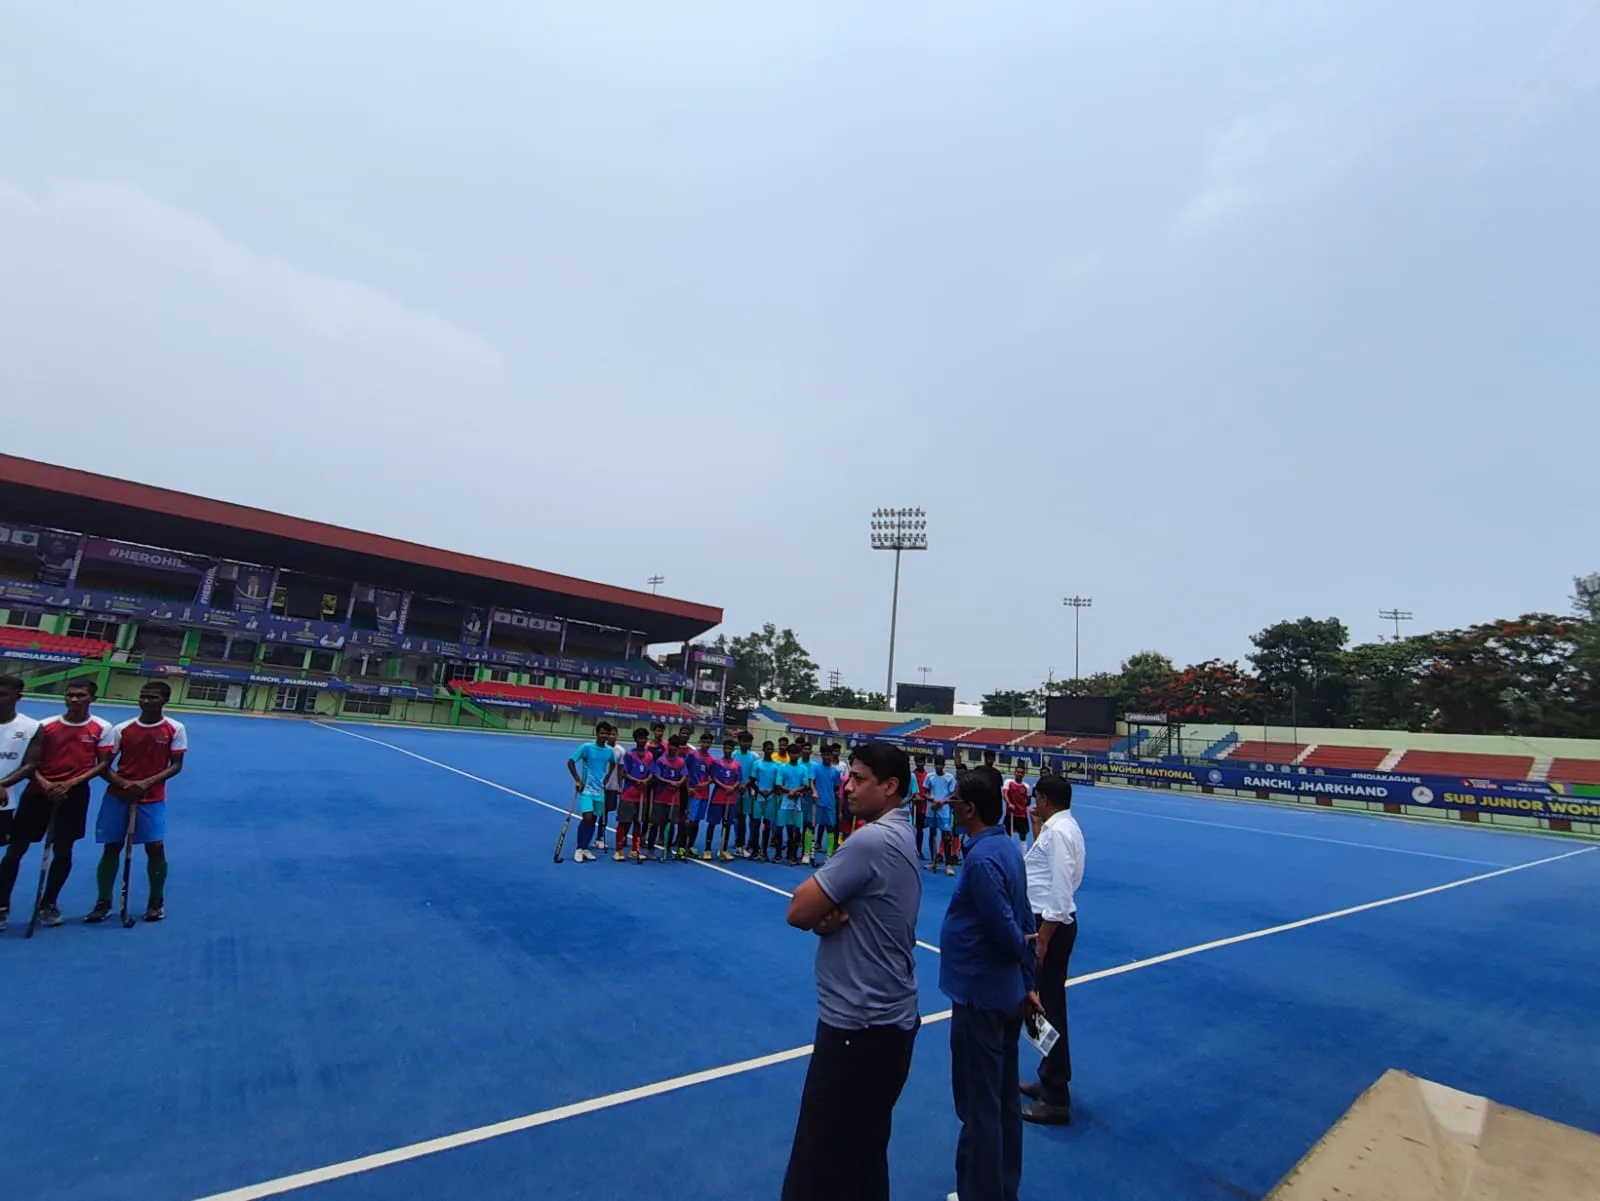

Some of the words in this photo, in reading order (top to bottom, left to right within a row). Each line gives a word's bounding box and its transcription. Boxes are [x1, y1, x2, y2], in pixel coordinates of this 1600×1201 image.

[109, 548, 187, 569] #HEROHIL
[1146, 768, 1195, 780] NATIONAL
[1351, 772, 1421, 784] #INDIAKAGAME
[1243, 776, 1296, 792] RANCHI,
[1298, 781, 1388, 798] JHARKHAND
[1443, 792, 1477, 805] SUB
[1480, 796, 1544, 812] JUNIOR
